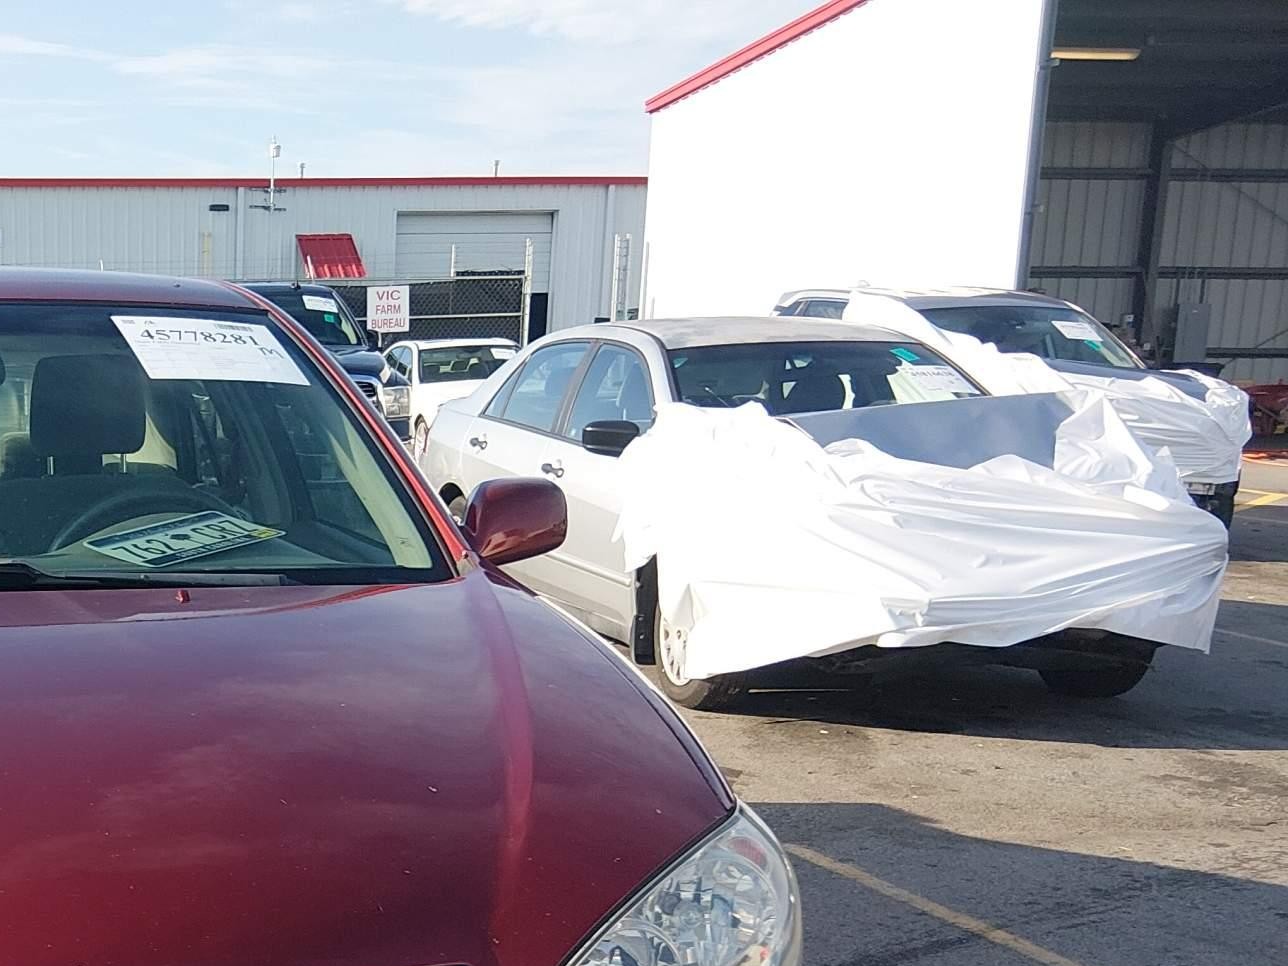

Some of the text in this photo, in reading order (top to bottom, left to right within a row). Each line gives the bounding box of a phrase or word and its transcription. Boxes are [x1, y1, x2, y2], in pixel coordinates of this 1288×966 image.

[376, 289, 401, 301] VIC
[375, 304, 401, 315] FARM
[371, 318, 406, 329] BUREAU
[140, 329, 260, 346] 45778281
[110, 538, 187, 560] 762
[190, 519, 260, 540] CRZ
